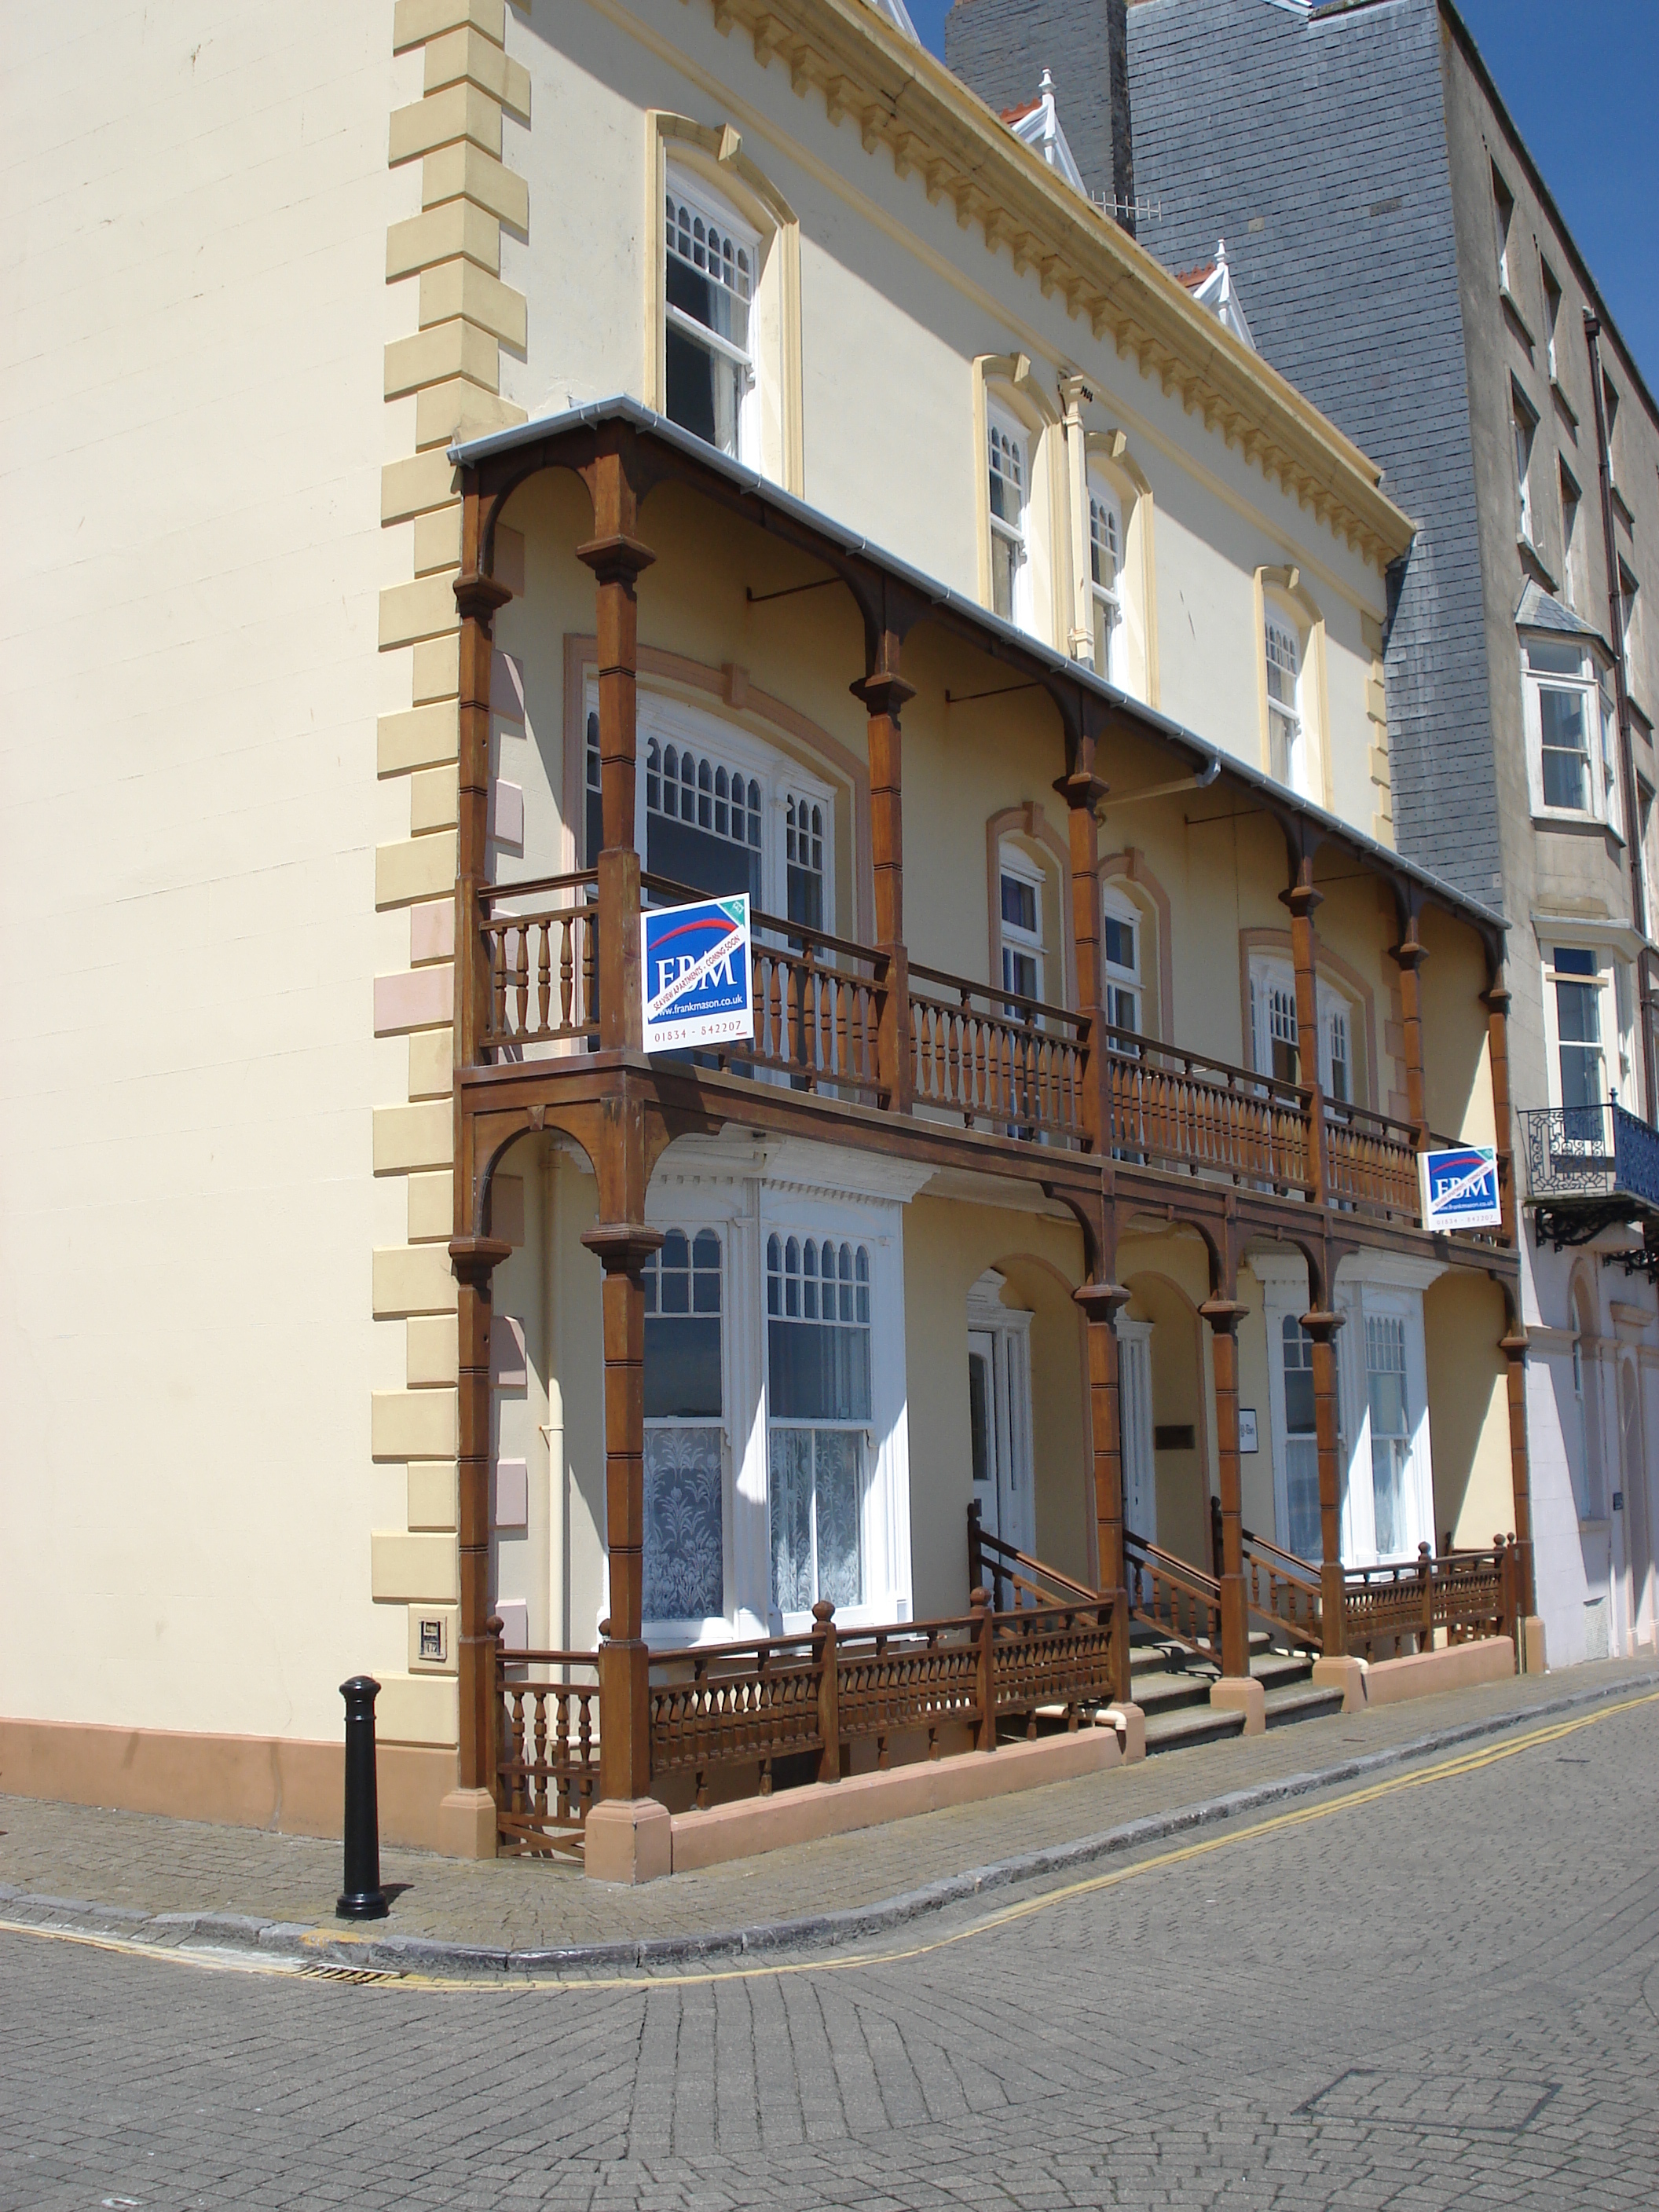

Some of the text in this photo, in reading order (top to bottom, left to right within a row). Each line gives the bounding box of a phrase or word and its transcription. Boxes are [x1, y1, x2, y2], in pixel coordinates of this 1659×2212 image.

[672, 965, 703, 994] APARTMENTS
[705, 947, 725, 967] COMING
[724, 934, 740, 951] SOON
[654, 1030, 686, 1042] 01834
[701, 1020, 741, 1035] 842207
